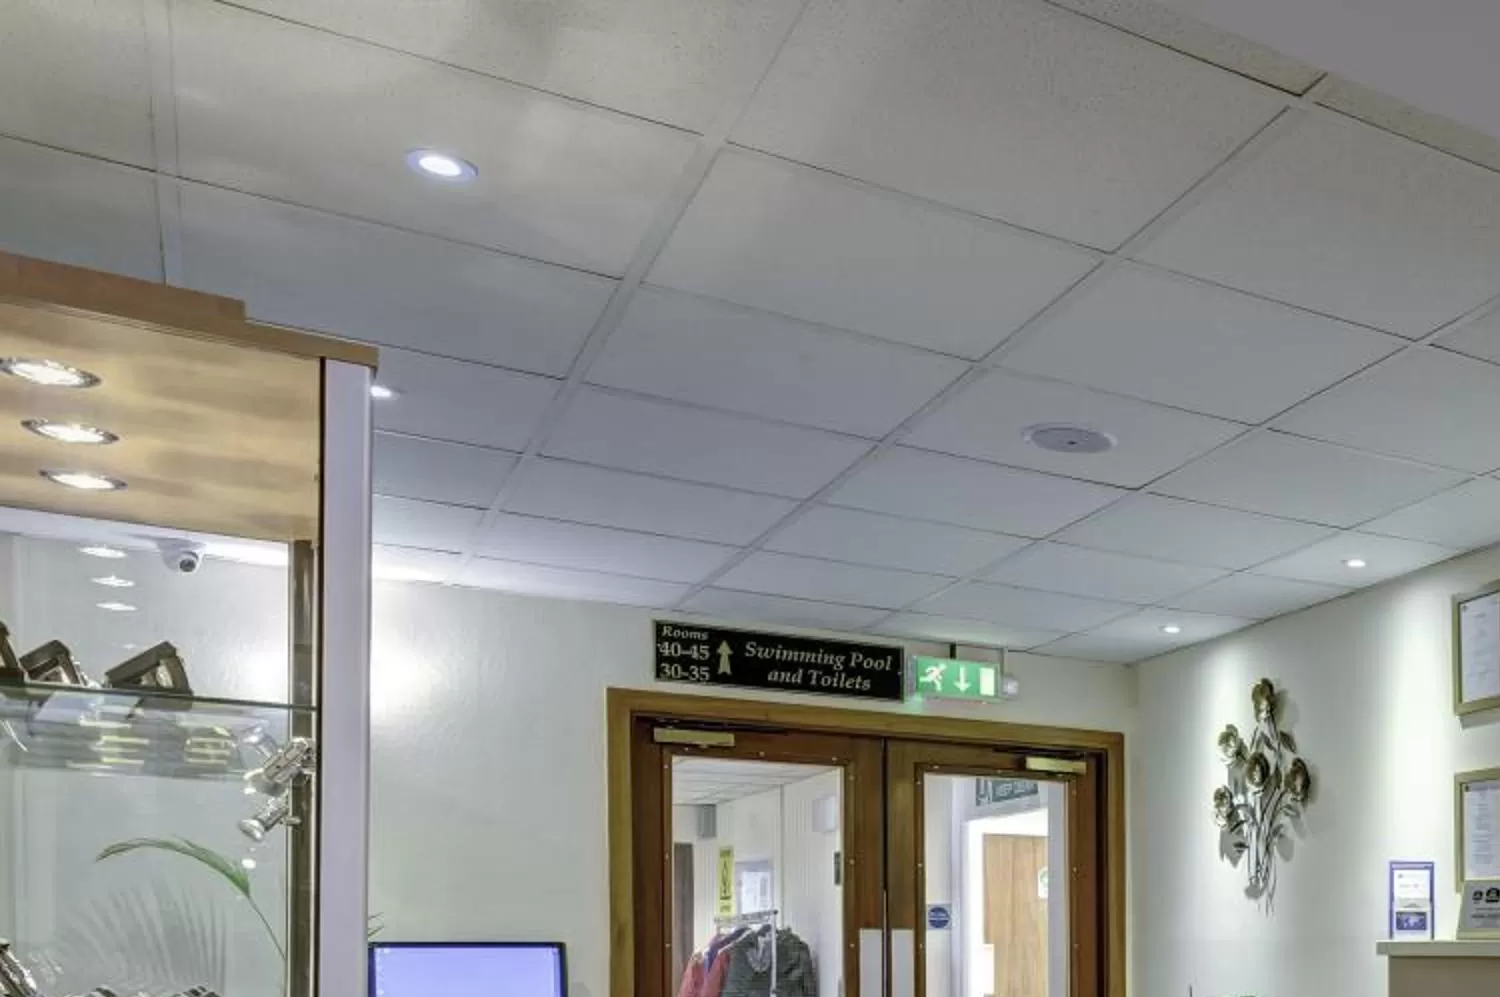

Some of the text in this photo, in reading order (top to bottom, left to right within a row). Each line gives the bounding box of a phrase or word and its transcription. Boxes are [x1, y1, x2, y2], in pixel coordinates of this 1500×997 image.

[661, 625, 709, 640] Rooms
[659, 641, 710, 661] 40-45
[744, 641, 894, 671] Swimming Pool
[660, 663, 710, 681] 30-35
[767, 669, 871, 691] and Toilets
